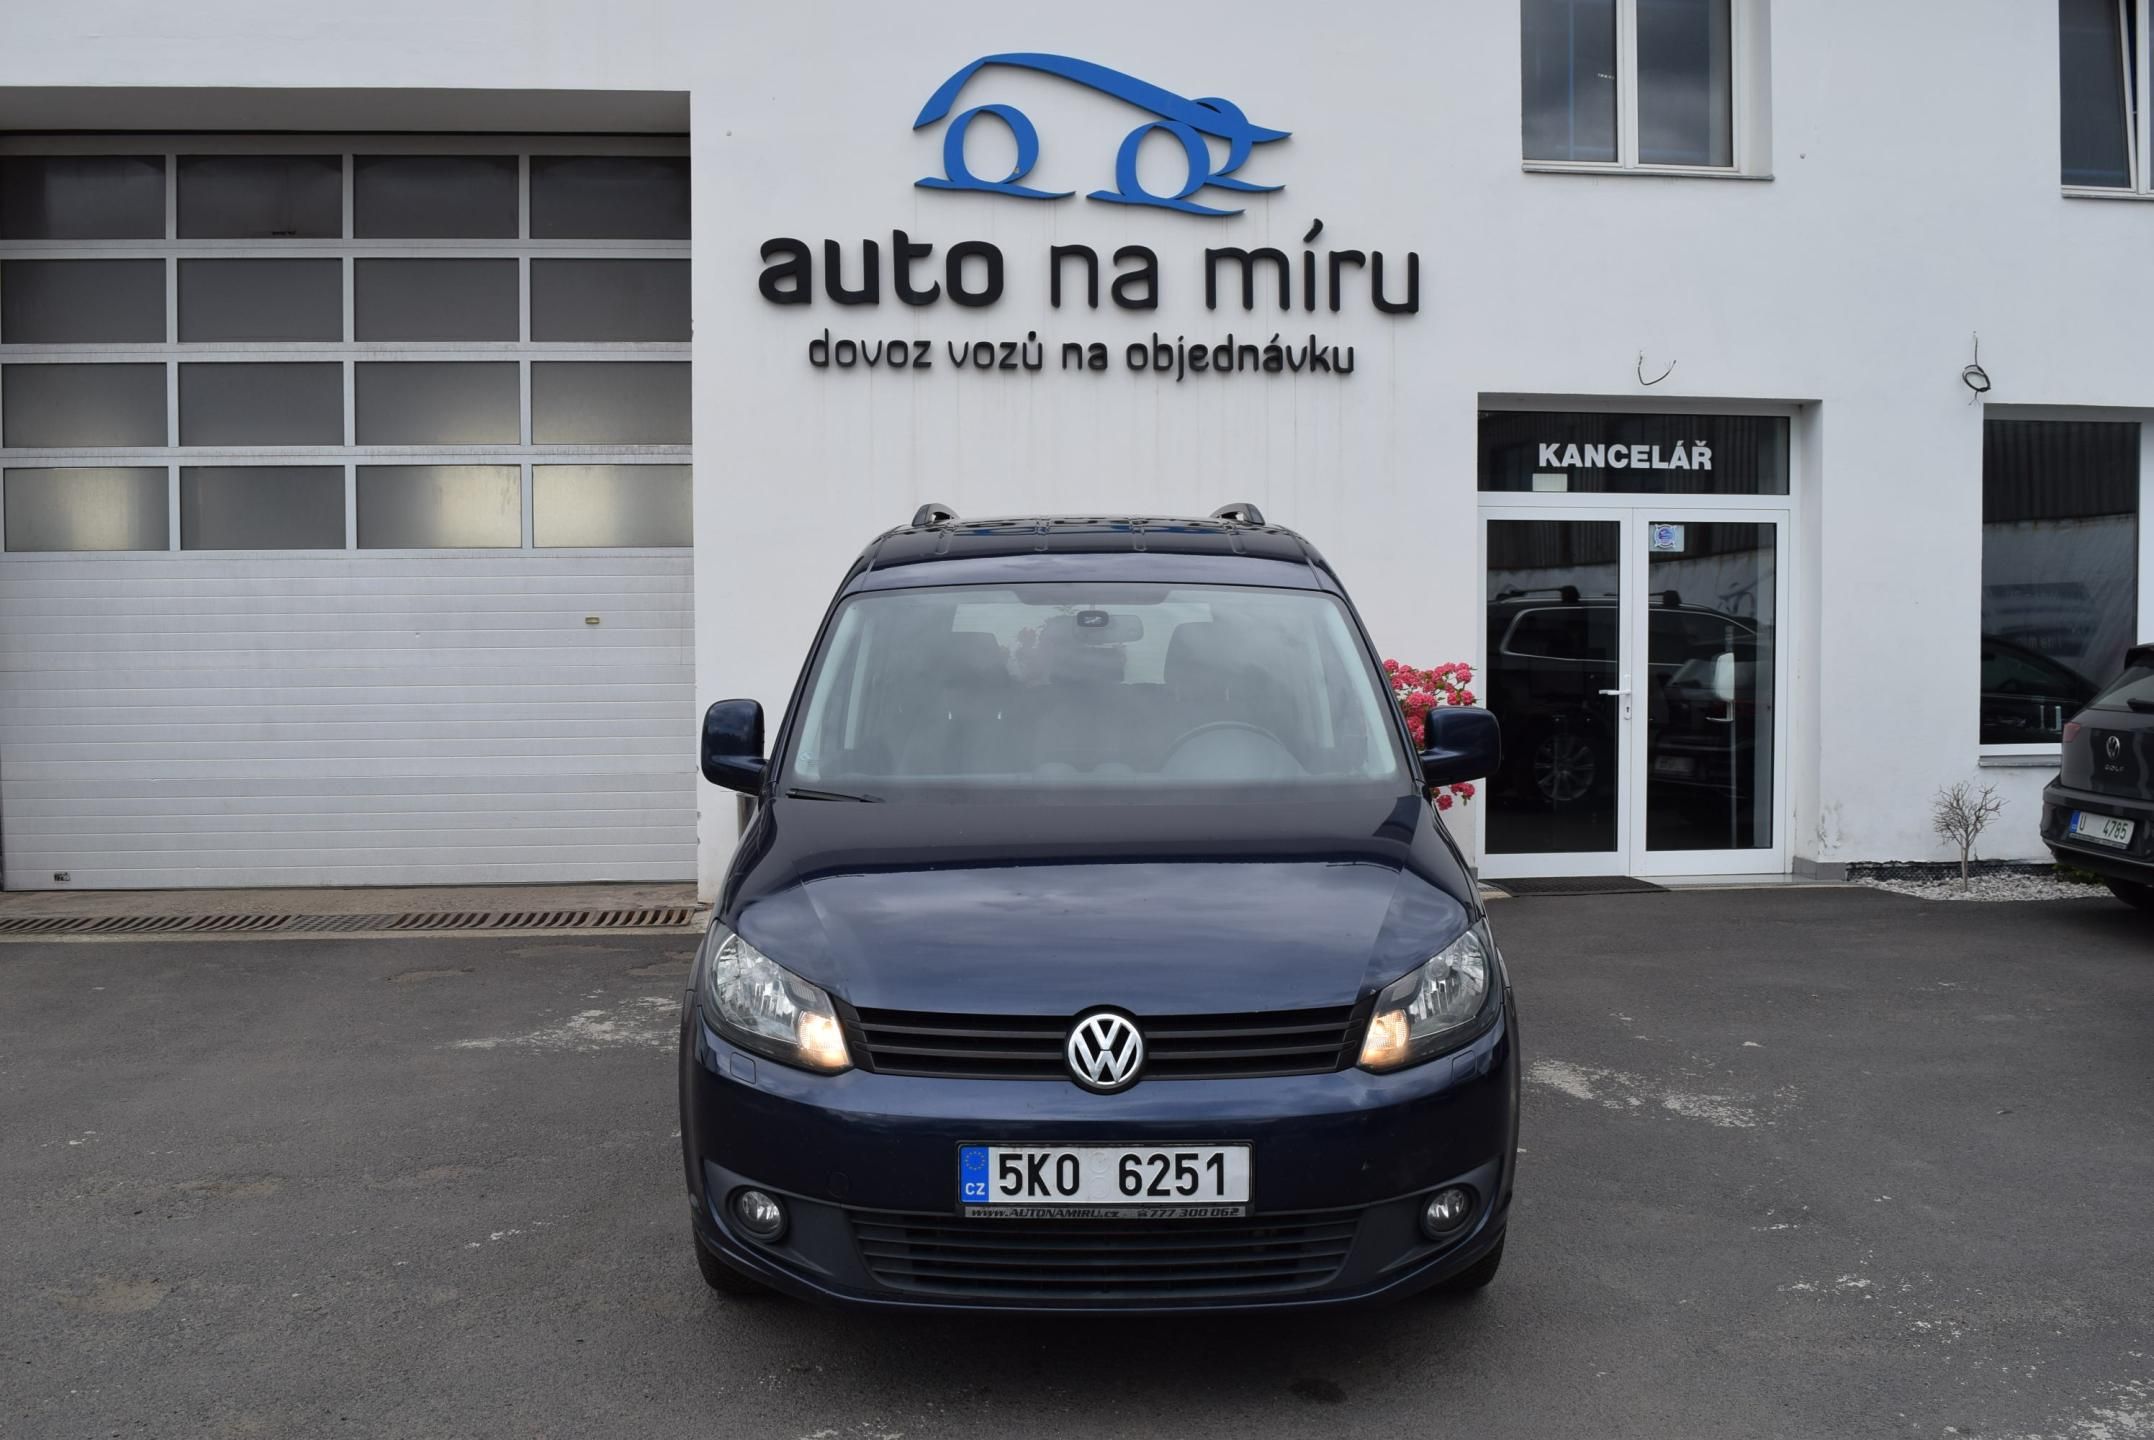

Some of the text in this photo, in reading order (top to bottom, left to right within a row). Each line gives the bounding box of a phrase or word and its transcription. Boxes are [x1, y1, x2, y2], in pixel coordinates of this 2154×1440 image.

[758, 218, 1420, 315] auto na míru
[808, 328, 1354, 382] dovoz vozů na objednávku
[1538, 439, 1713, 471] KANCELÁŘ
[2103, 819, 2129, 840] 4785
[965, 1183, 986, 1196] CZ
[999, 1152, 1225, 1197] 5K0 6251
[1150, 1208, 1177, 1218] 777
